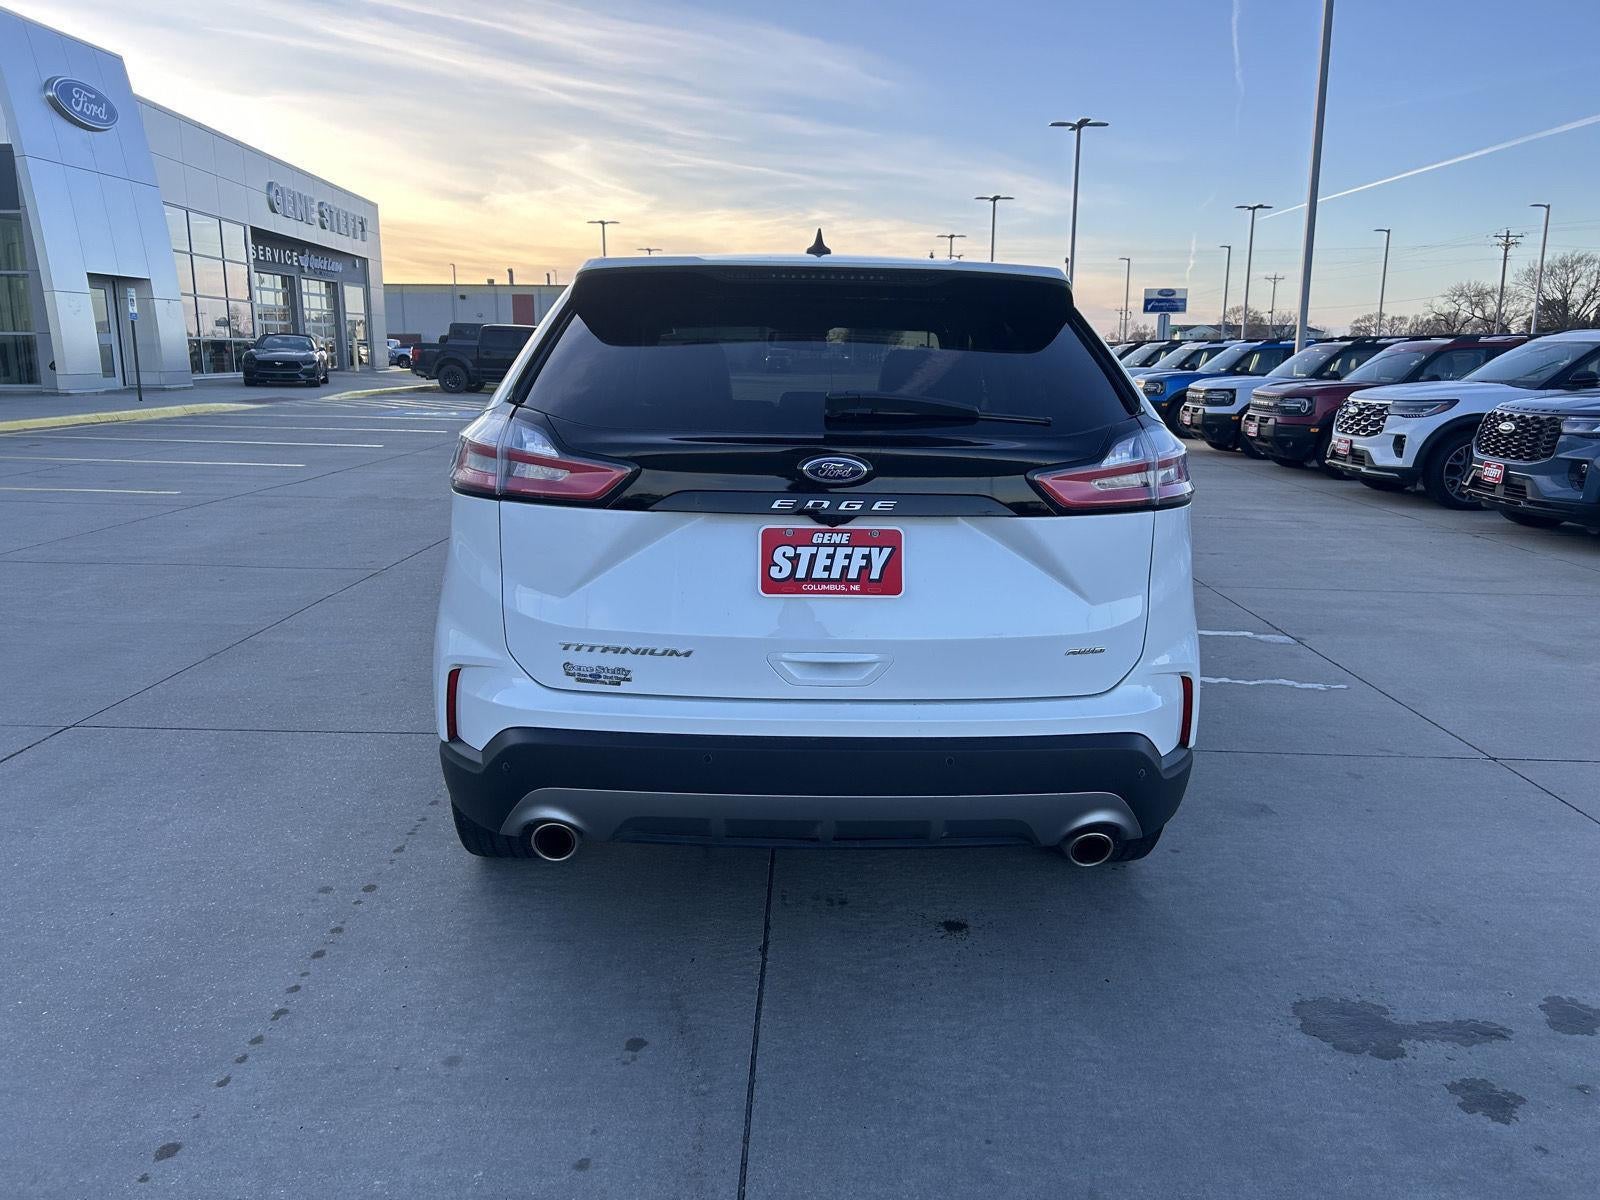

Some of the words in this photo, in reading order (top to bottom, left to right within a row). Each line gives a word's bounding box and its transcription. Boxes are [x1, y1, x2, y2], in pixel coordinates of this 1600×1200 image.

[72, 87, 107, 120] Ford
[266, 181, 316, 225] GENE
[318, 201, 368, 241] STEFFY
[252, 245, 299, 266] SERVICE
[818, 462, 852, 478] Ford
[771, 499, 898, 511] EDGE
[812, 532, 851, 544] GENE
[769, 545, 894, 581] STEFFY
[802, 584, 848, 592] COLUMBUS,
[559, 642, 695, 658] TITANIUM
